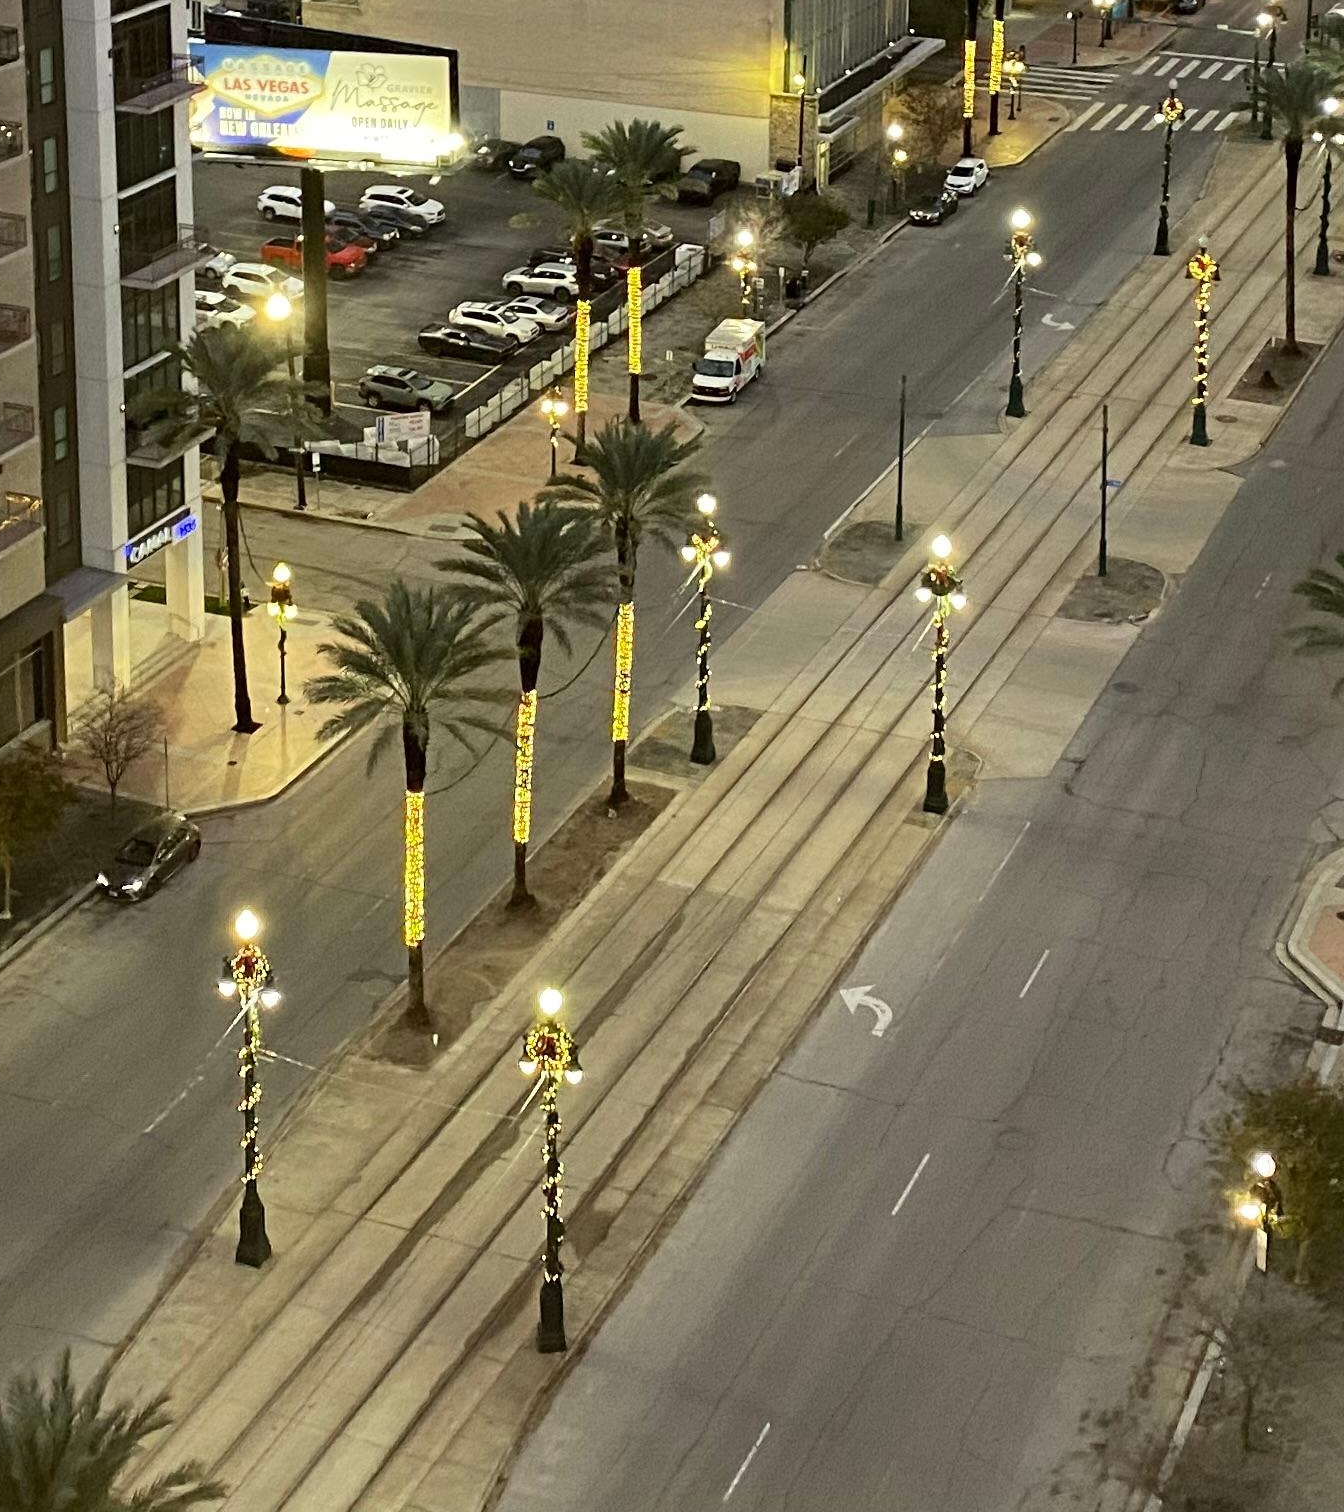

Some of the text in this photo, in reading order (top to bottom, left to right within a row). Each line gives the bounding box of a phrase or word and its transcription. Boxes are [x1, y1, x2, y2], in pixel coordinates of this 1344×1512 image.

[223, 77, 310, 94] LAS VEGAS
[386, 84, 433, 94] GRAVIER
[244, 93, 289, 102] NEVADA
[330, 79, 439, 128] Massage
[219, 120, 303, 138] NEW ORLEAN
[351, 116, 409, 130] OPEN DAILY
[129, 527, 172, 563] CANAL
